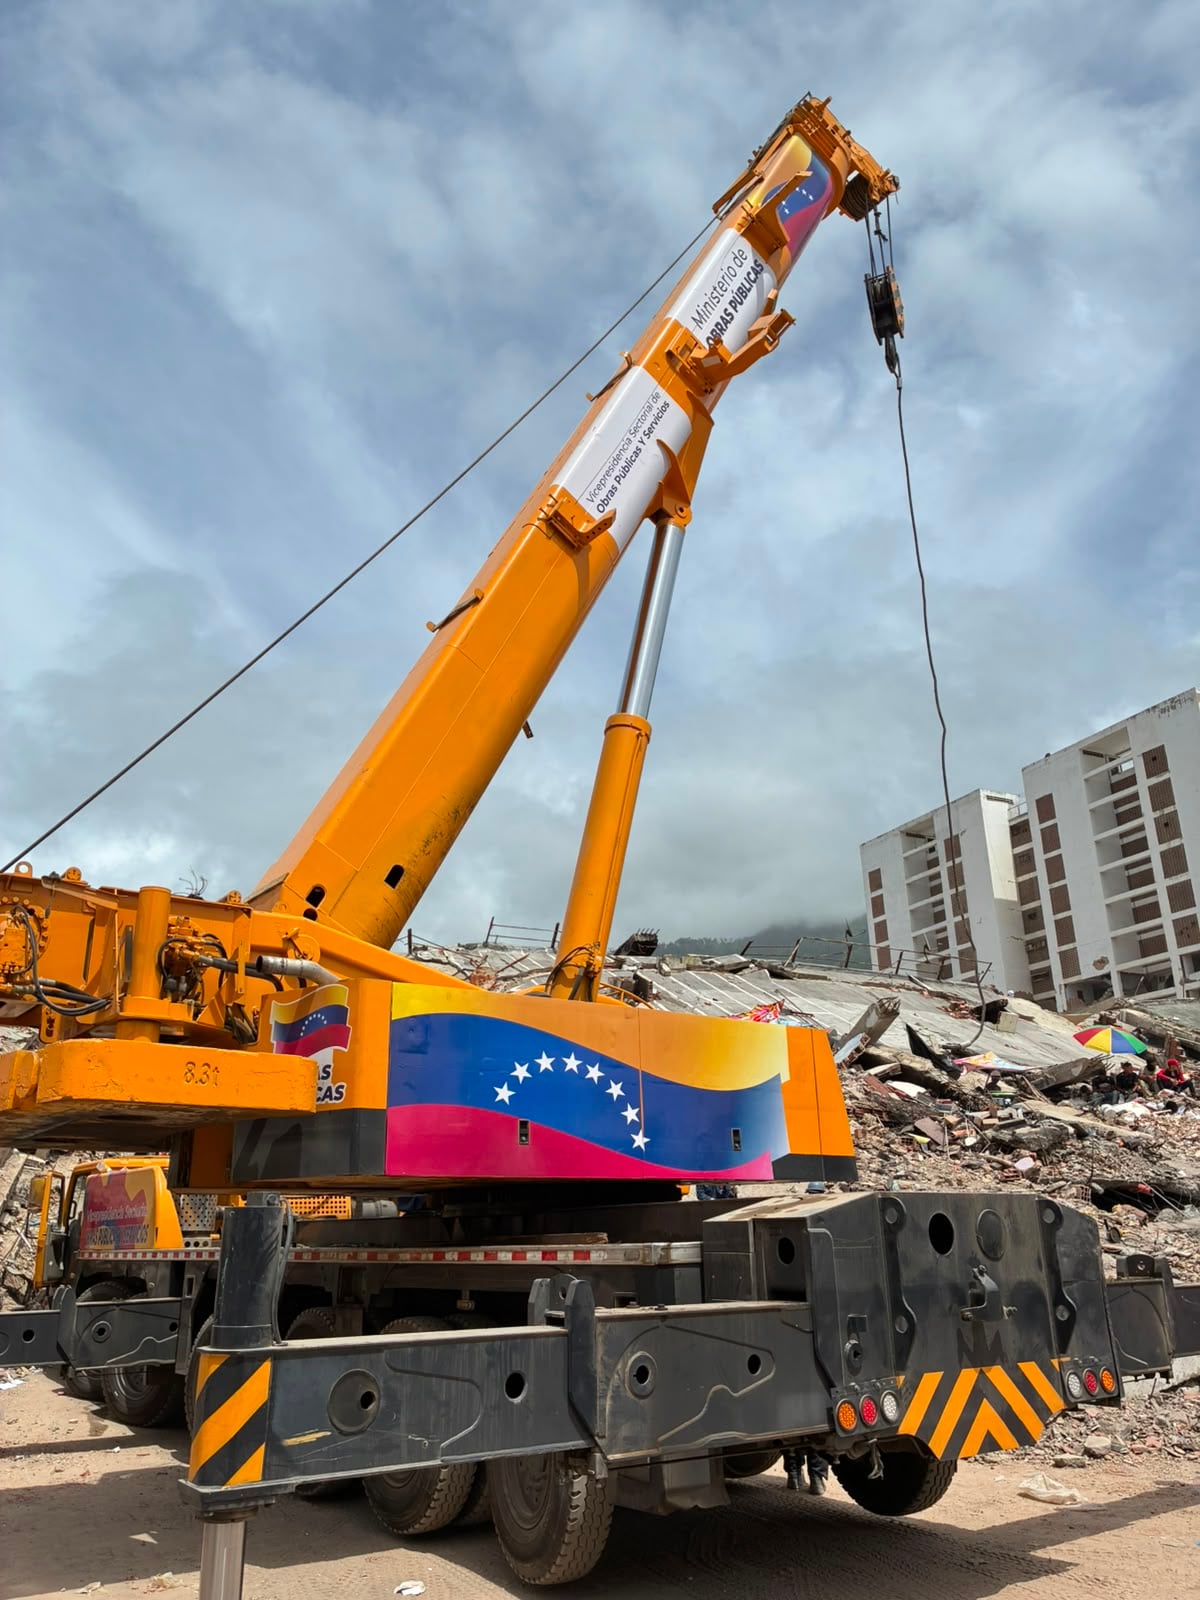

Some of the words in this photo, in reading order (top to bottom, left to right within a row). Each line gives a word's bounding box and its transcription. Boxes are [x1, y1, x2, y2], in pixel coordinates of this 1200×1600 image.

[691, 265, 737, 330] Ministerio
[731, 248, 748, 269] de
[728, 258, 764, 313] PÚBLICAS
[586, 436, 633, 504] Vicepresidencia
[628, 401, 655, 438] Sectorial
[650, 391, 661, 403] de
[596, 483, 618, 514] Obras
[614, 445, 641, 485] Públicas
[638, 436, 646, 446] Y
[643, 400, 670, 440] Servicios
